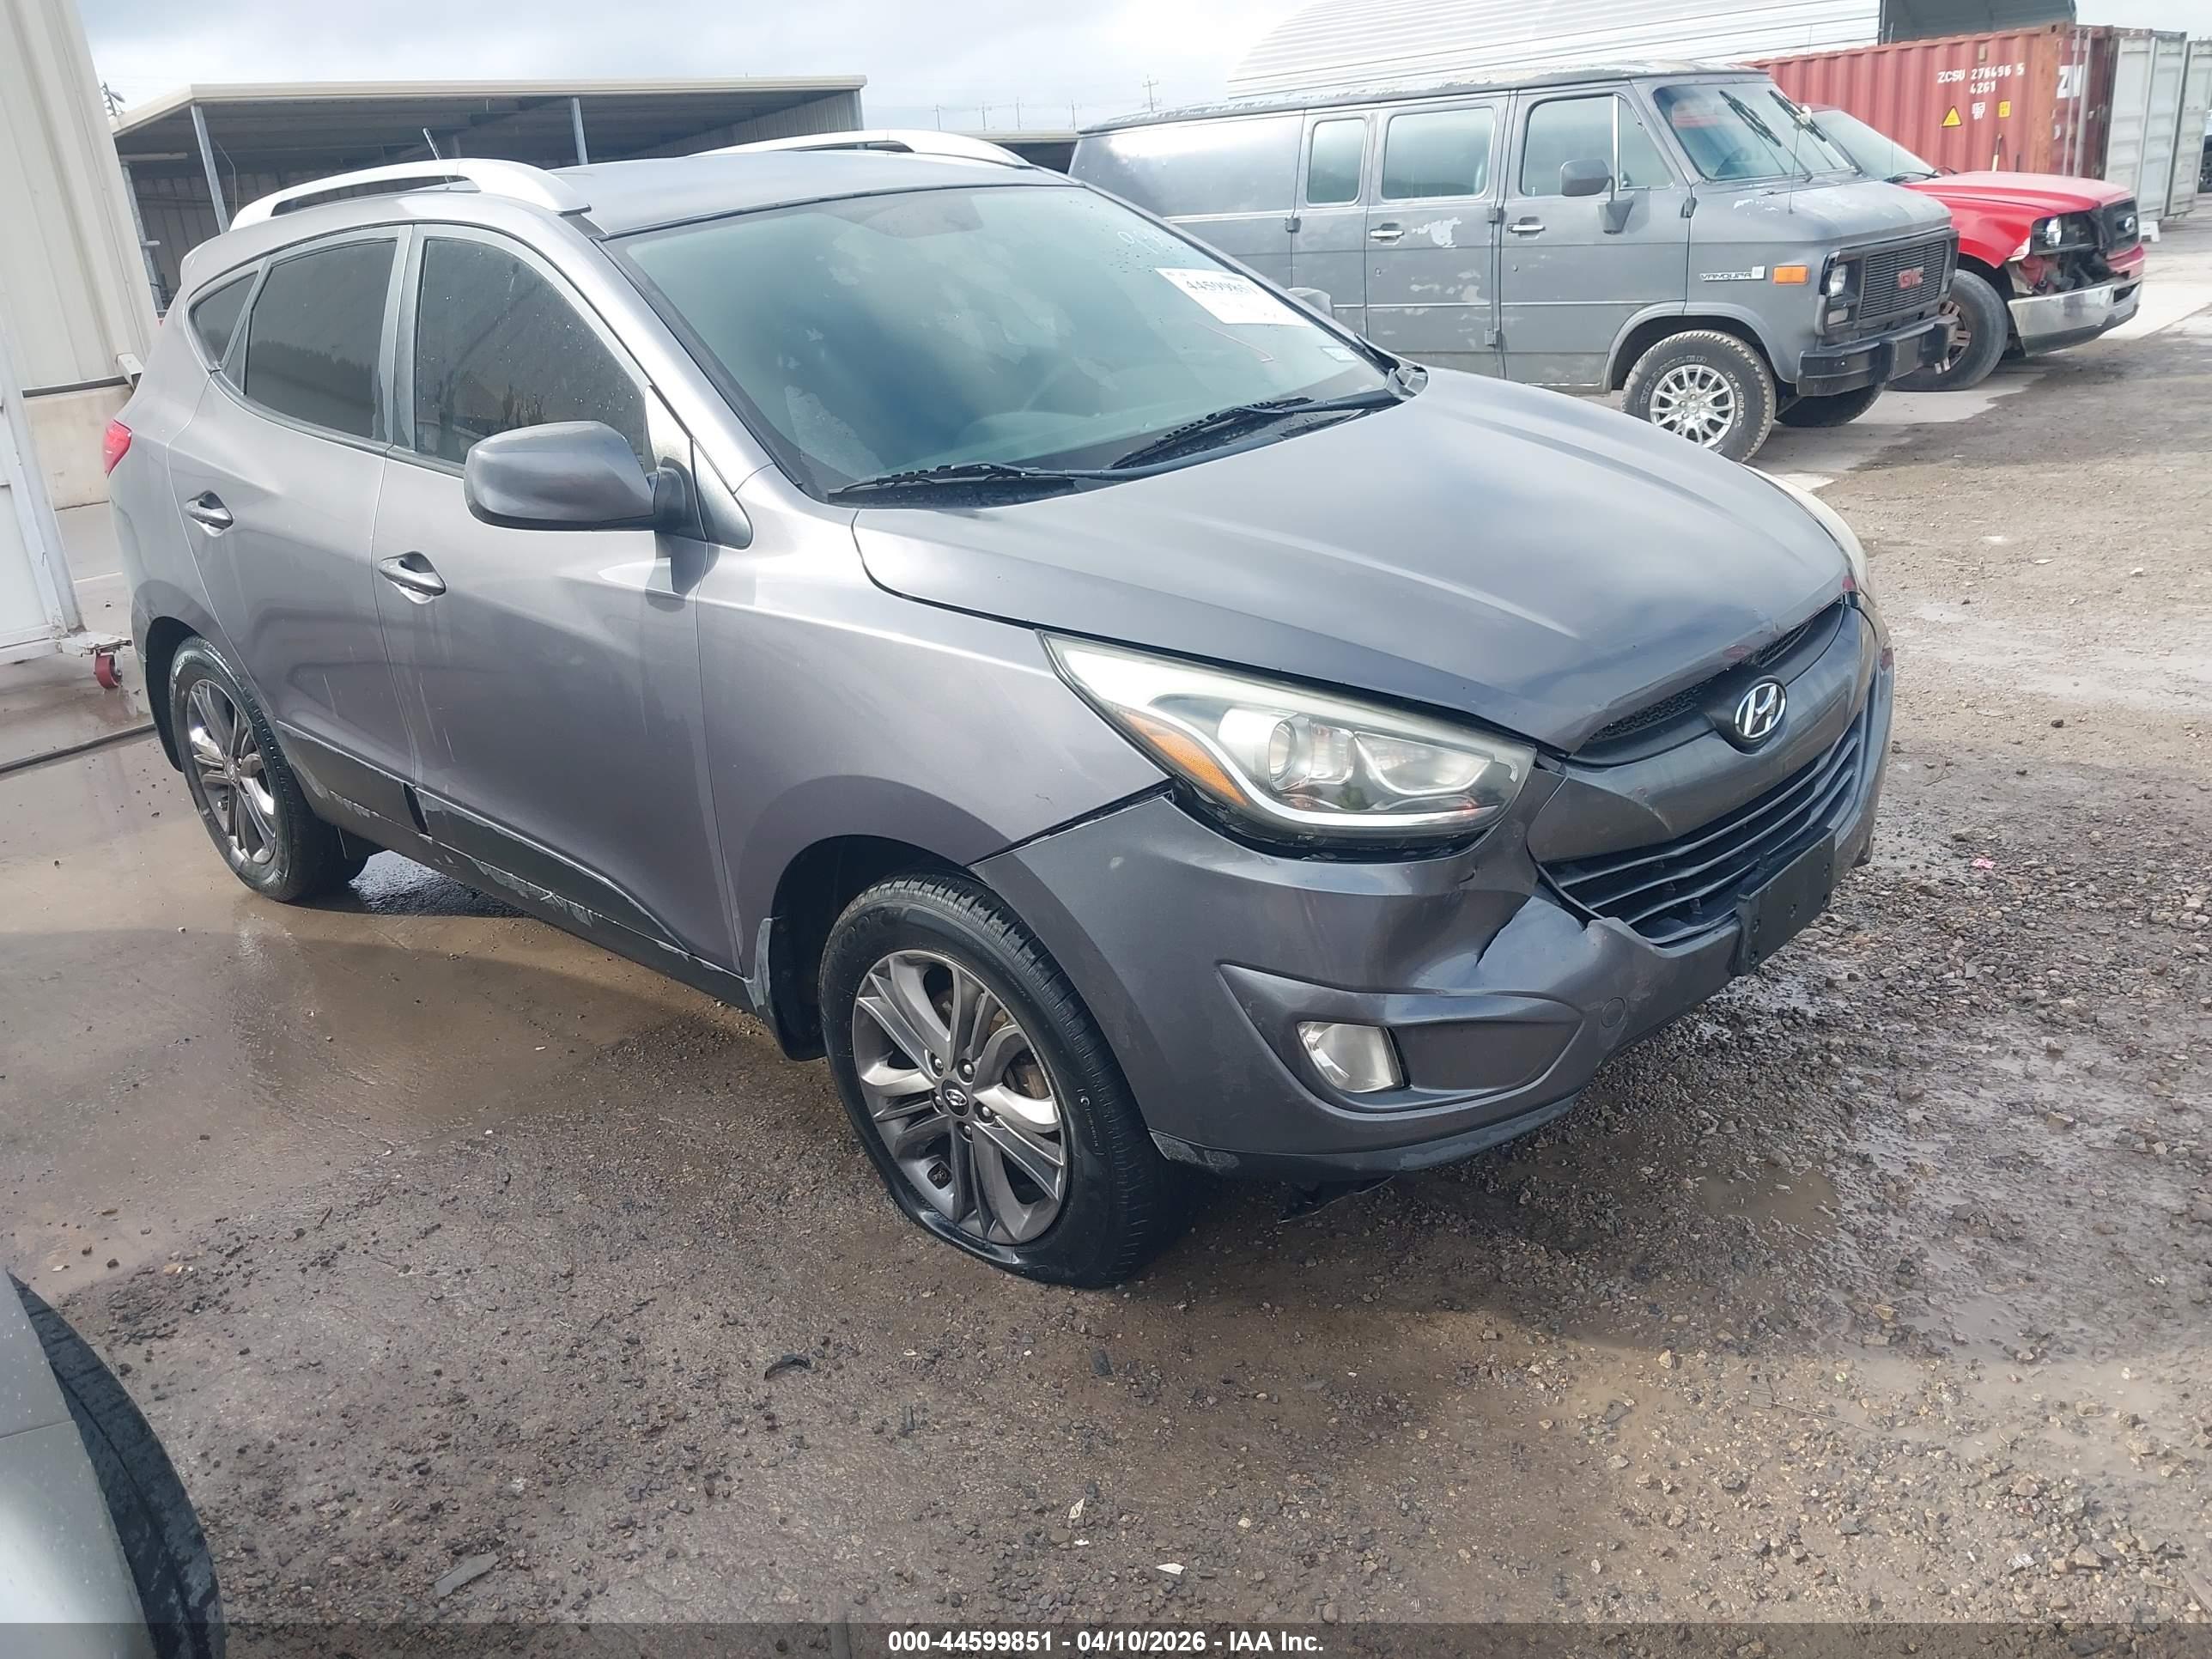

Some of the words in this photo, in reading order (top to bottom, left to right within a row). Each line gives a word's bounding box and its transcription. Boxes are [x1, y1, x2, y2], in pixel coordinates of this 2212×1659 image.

[1937, 69, 1966, 83] ZCSU
[2016, 63, 2025, 76] 5
[1898, 267, 1924, 289] GMC
